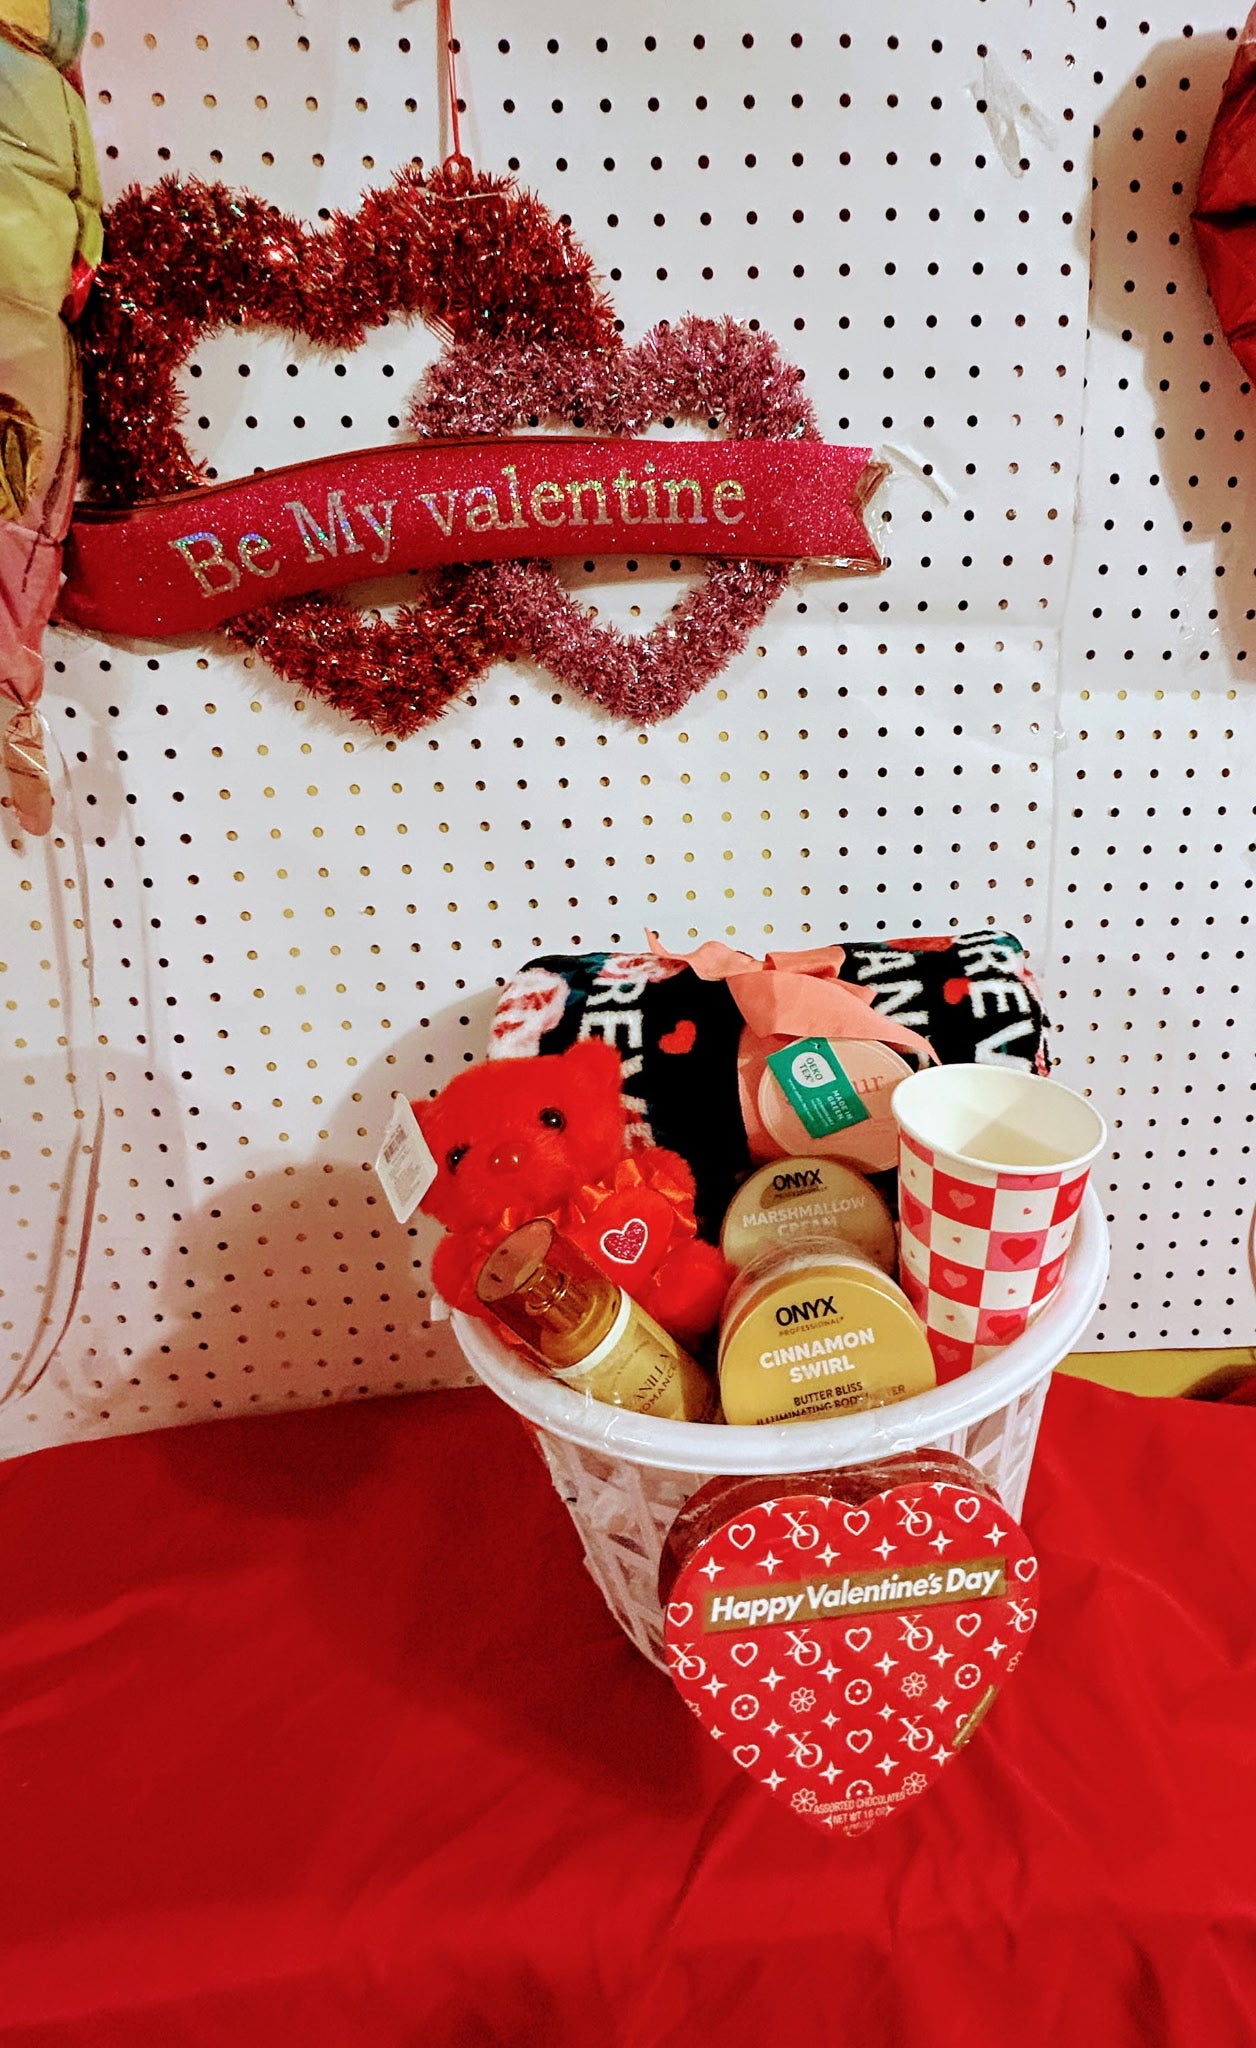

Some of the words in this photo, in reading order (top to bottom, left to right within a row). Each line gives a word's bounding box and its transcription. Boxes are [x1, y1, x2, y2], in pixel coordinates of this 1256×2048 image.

[168, 531, 280, 598] Be
[284, 489, 397, 563] My
[418, 459, 746, 537] valentine
[806, 1057, 823, 1081] OEKO
[827, 1096, 845, 1119] GREEN
[832, 1090, 848, 1112] MADE
[772, 1169, 823, 1191] ONYX
[742, 1196, 866, 1228] MARSHMALLOW
[775, 1296, 838, 1327] ONYX
[759, 1328, 875, 1369] CINNAMON
[789, 1355, 855, 1384] SWIRL
[793, 1389, 833, 1407] BUTTER
[835, 1381, 863, 1396] BLISS
[710, 1594, 805, 1625] Happy
[806, 1573, 943, 1610] Valentine's
[945, 1567, 1001, 1596] Day
[814, 1799, 855, 1814] ASSORTED
[856, 1790, 906, 1809] CHOCOLATES
